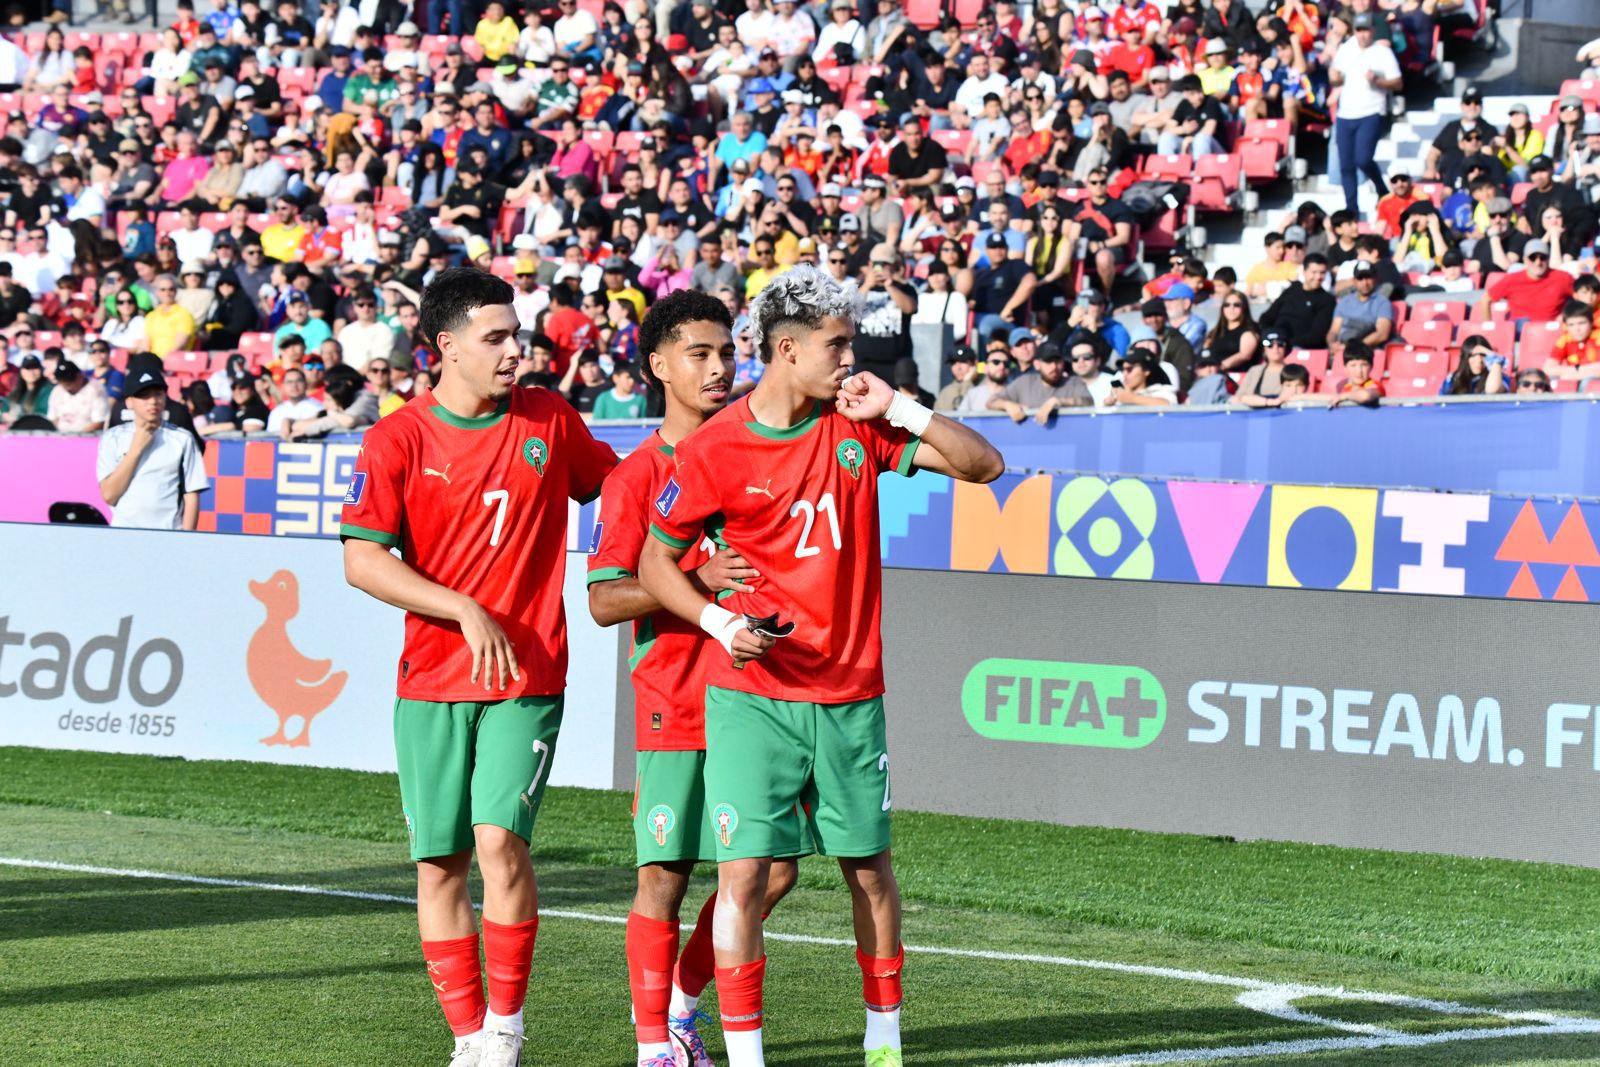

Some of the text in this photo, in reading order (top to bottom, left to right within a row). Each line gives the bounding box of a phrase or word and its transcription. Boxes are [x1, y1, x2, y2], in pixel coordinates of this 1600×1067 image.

[483, 489, 509, 547] 7
[790, 493, 842, 558] 21
[0, 615, 184, 708] tado
[58, 709, 177, 737] desde 1855
[985, 675, 1158, 737] FIFA+
[1187, 680, 1525, 767] STREAM.
[533, 739, 549, 797] 7
